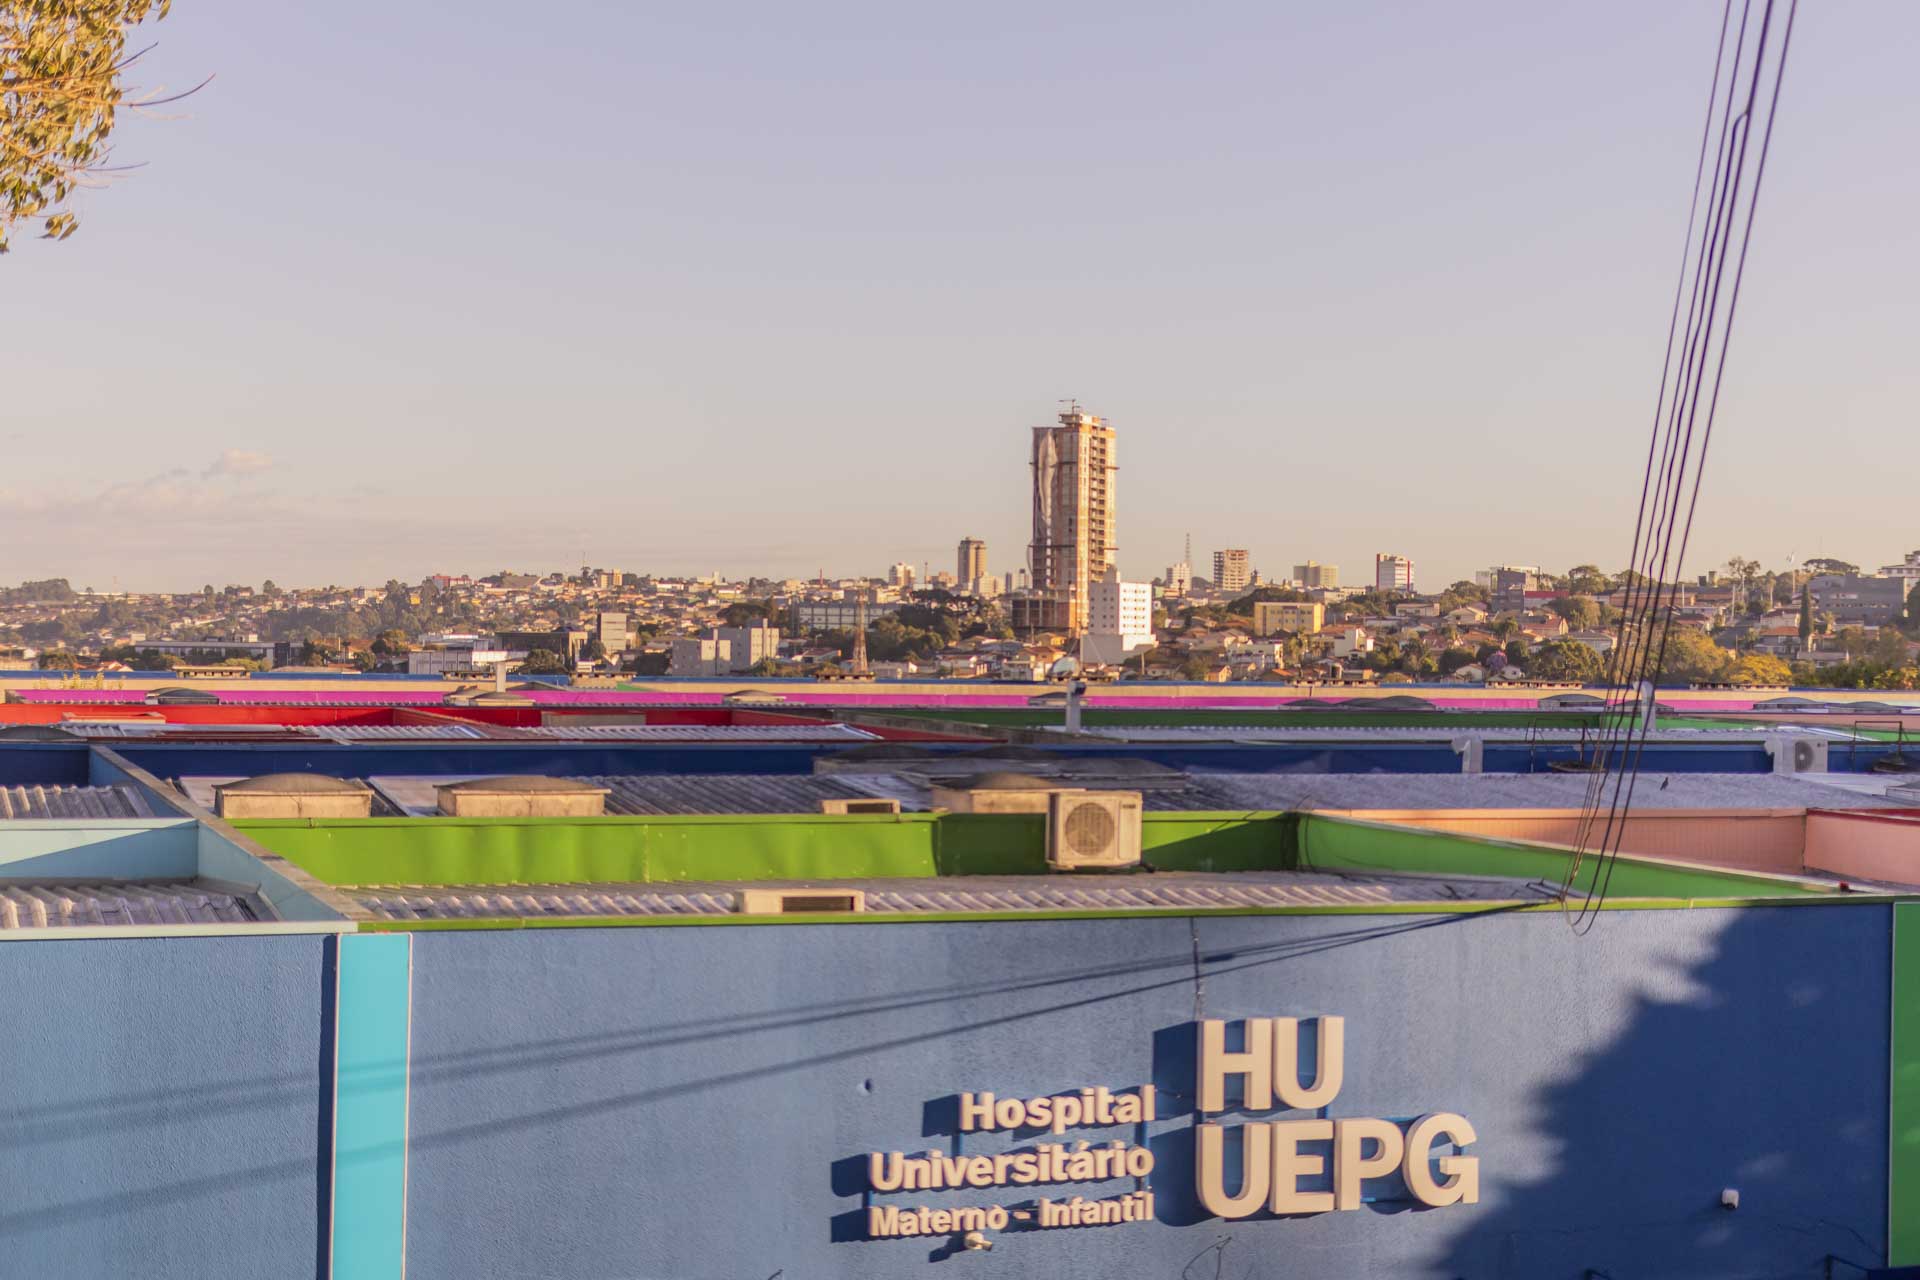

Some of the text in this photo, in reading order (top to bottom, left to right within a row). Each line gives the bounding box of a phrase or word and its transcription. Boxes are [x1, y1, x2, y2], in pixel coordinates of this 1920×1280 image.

[1197, 1016, 1344, 1112] HU
[960, 1084, 1155, 1135] Hospital
[871, 1139, 1155, 1191] Universitário
[1196, 1112, 1480, 1218] UEPG
[870, 1204, 1009, 1236] Materno
[1039, 1190, 1155, 1227] Infantil
